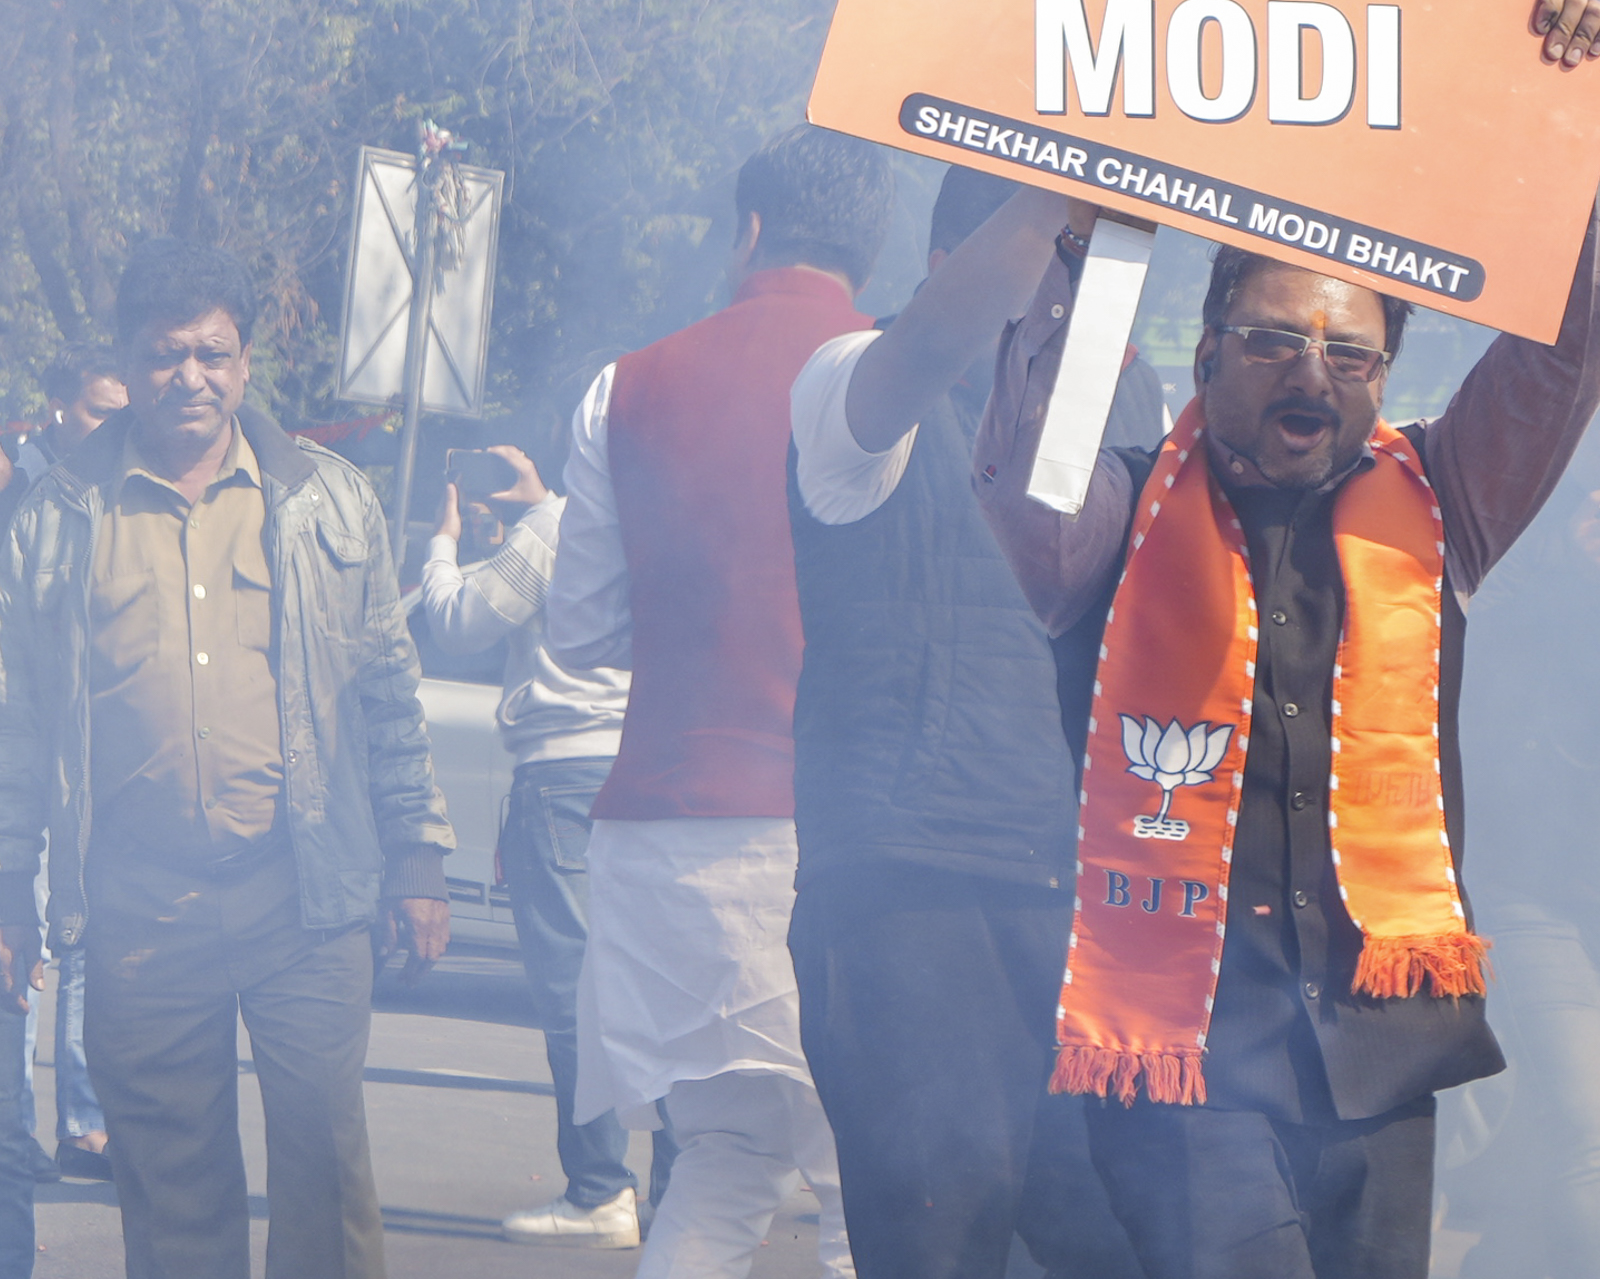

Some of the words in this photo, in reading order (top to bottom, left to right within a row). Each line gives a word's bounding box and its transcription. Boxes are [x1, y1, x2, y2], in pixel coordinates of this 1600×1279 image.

[914, 106, 1089, 178] SHEKHAR
[1096, 156, 1238, 225] CHAHAL
[1247, 202, 1341, 256] MODI
[1344, 233, 1470, 295] BHAKT
